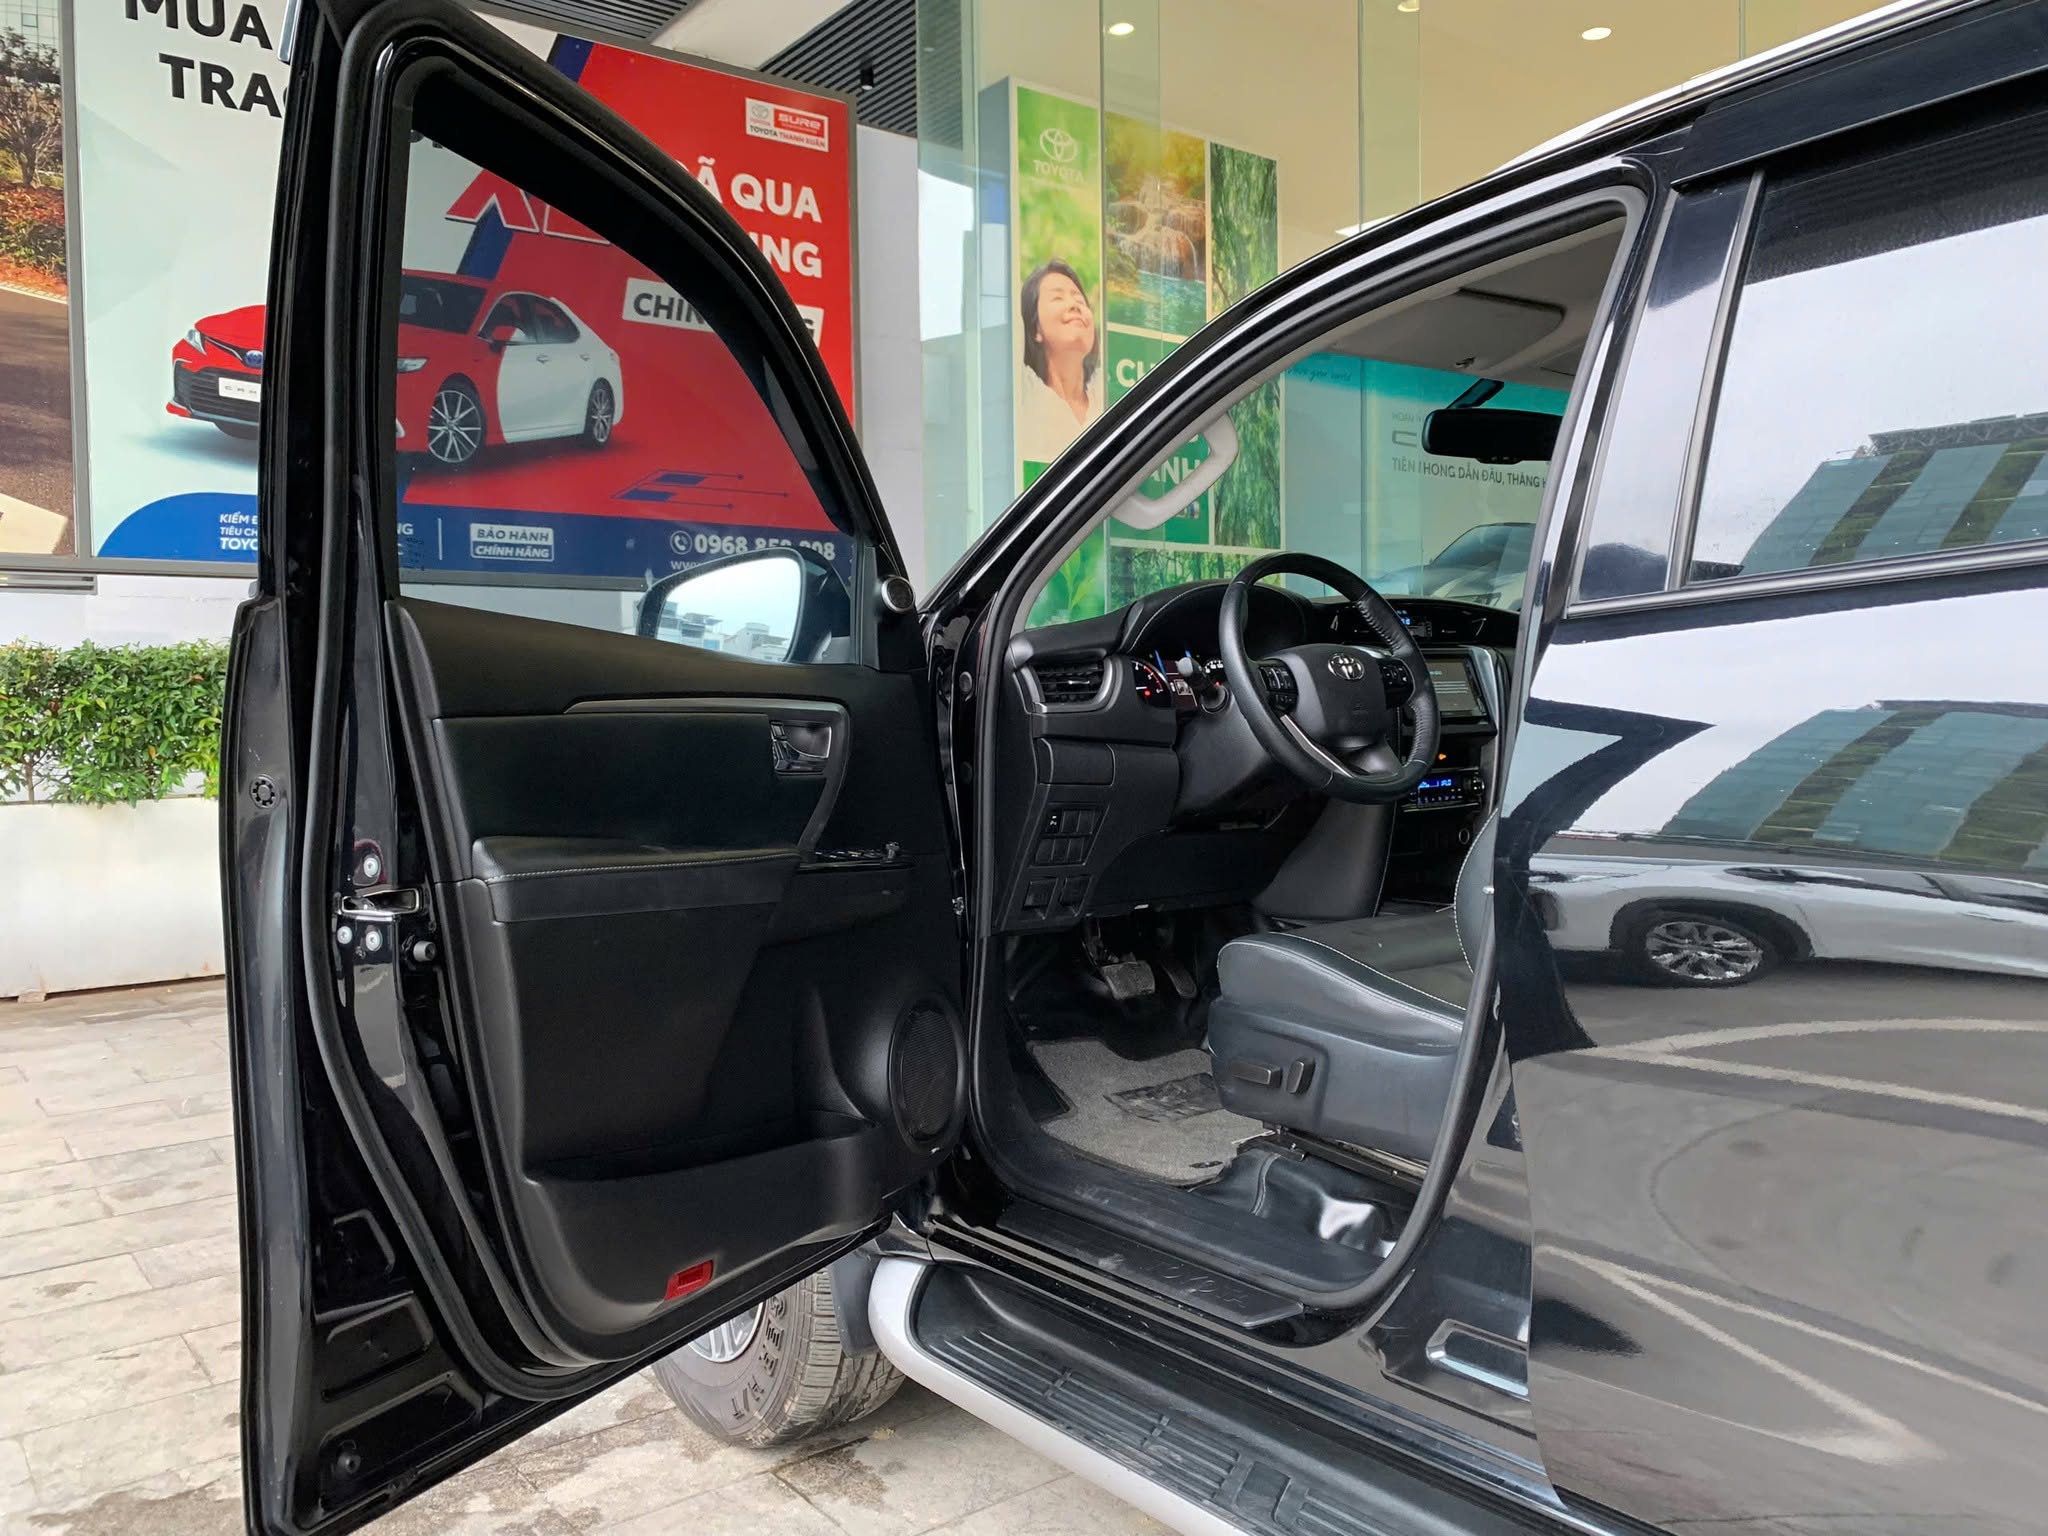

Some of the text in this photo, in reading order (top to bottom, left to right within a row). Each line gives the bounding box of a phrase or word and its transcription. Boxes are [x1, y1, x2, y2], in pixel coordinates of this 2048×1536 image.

[159, 53, 288, 118] TRA
[750, 125, 778, 137] TOYOTA
[1033, 159, 1084, 182] TOYOTA
[730, 173, 823, 224] QUA
[694, 533, 748, 554] 0968
